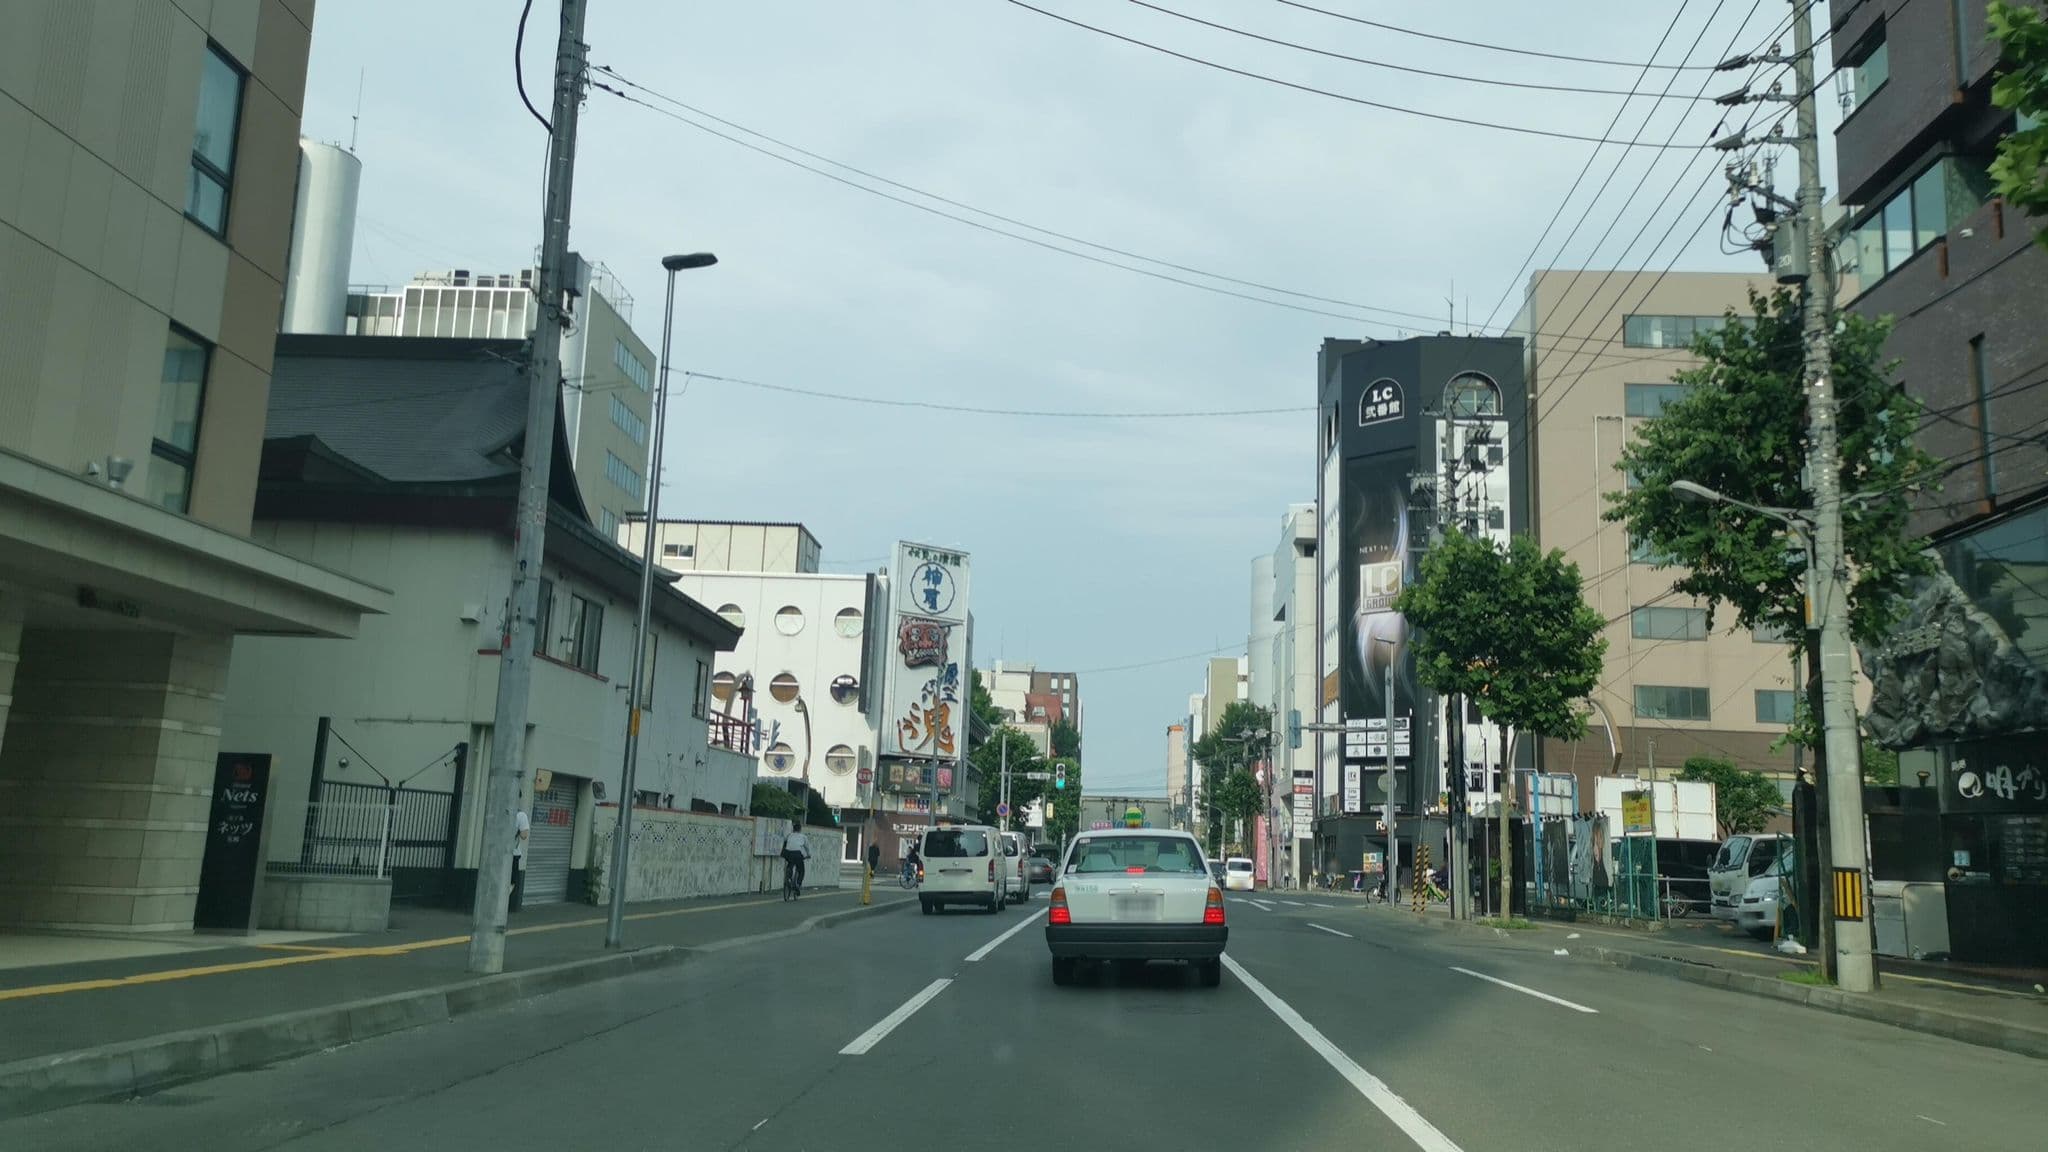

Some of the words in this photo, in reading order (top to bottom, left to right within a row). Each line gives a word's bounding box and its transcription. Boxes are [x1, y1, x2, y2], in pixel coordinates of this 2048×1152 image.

[1372, 386, 1393, 403] LC
[1366, 566, 1398, 597] LC
[220, 788, 259, 803] Nets
[217, 821, 254, 836] ネッツ
